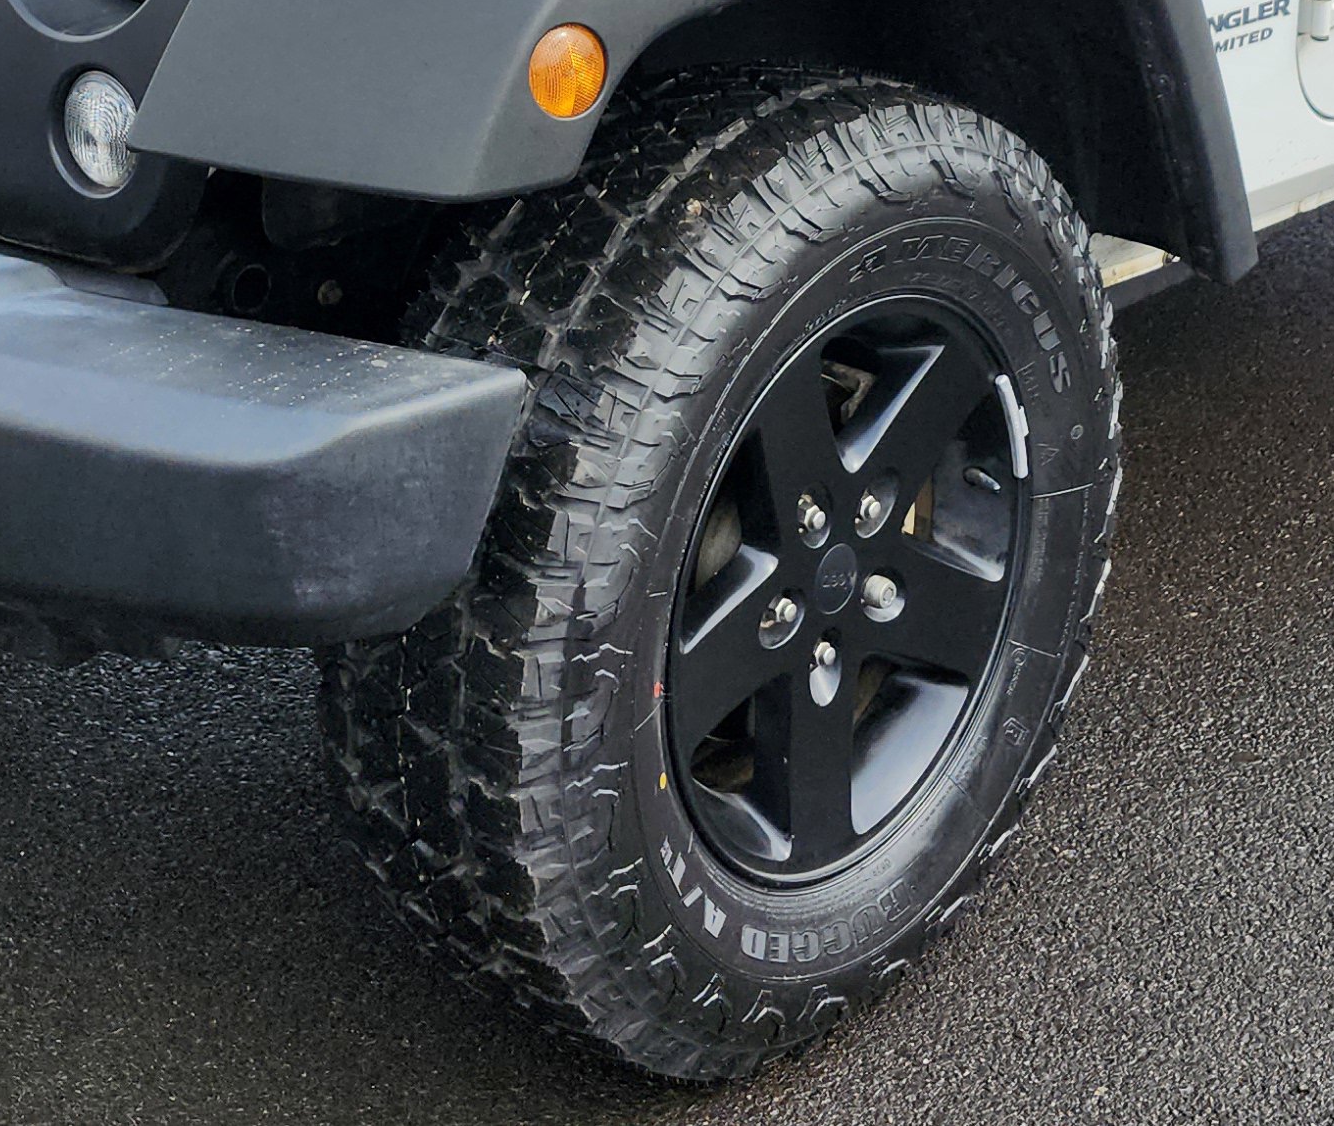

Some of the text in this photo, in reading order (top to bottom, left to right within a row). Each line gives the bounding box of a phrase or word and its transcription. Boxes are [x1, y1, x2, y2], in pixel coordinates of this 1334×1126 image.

[1215, 27, 1273, 53] MITED
[848, 235, 1071, 393] AMERICUS
[741, 877, 915, 963] RUGGED
